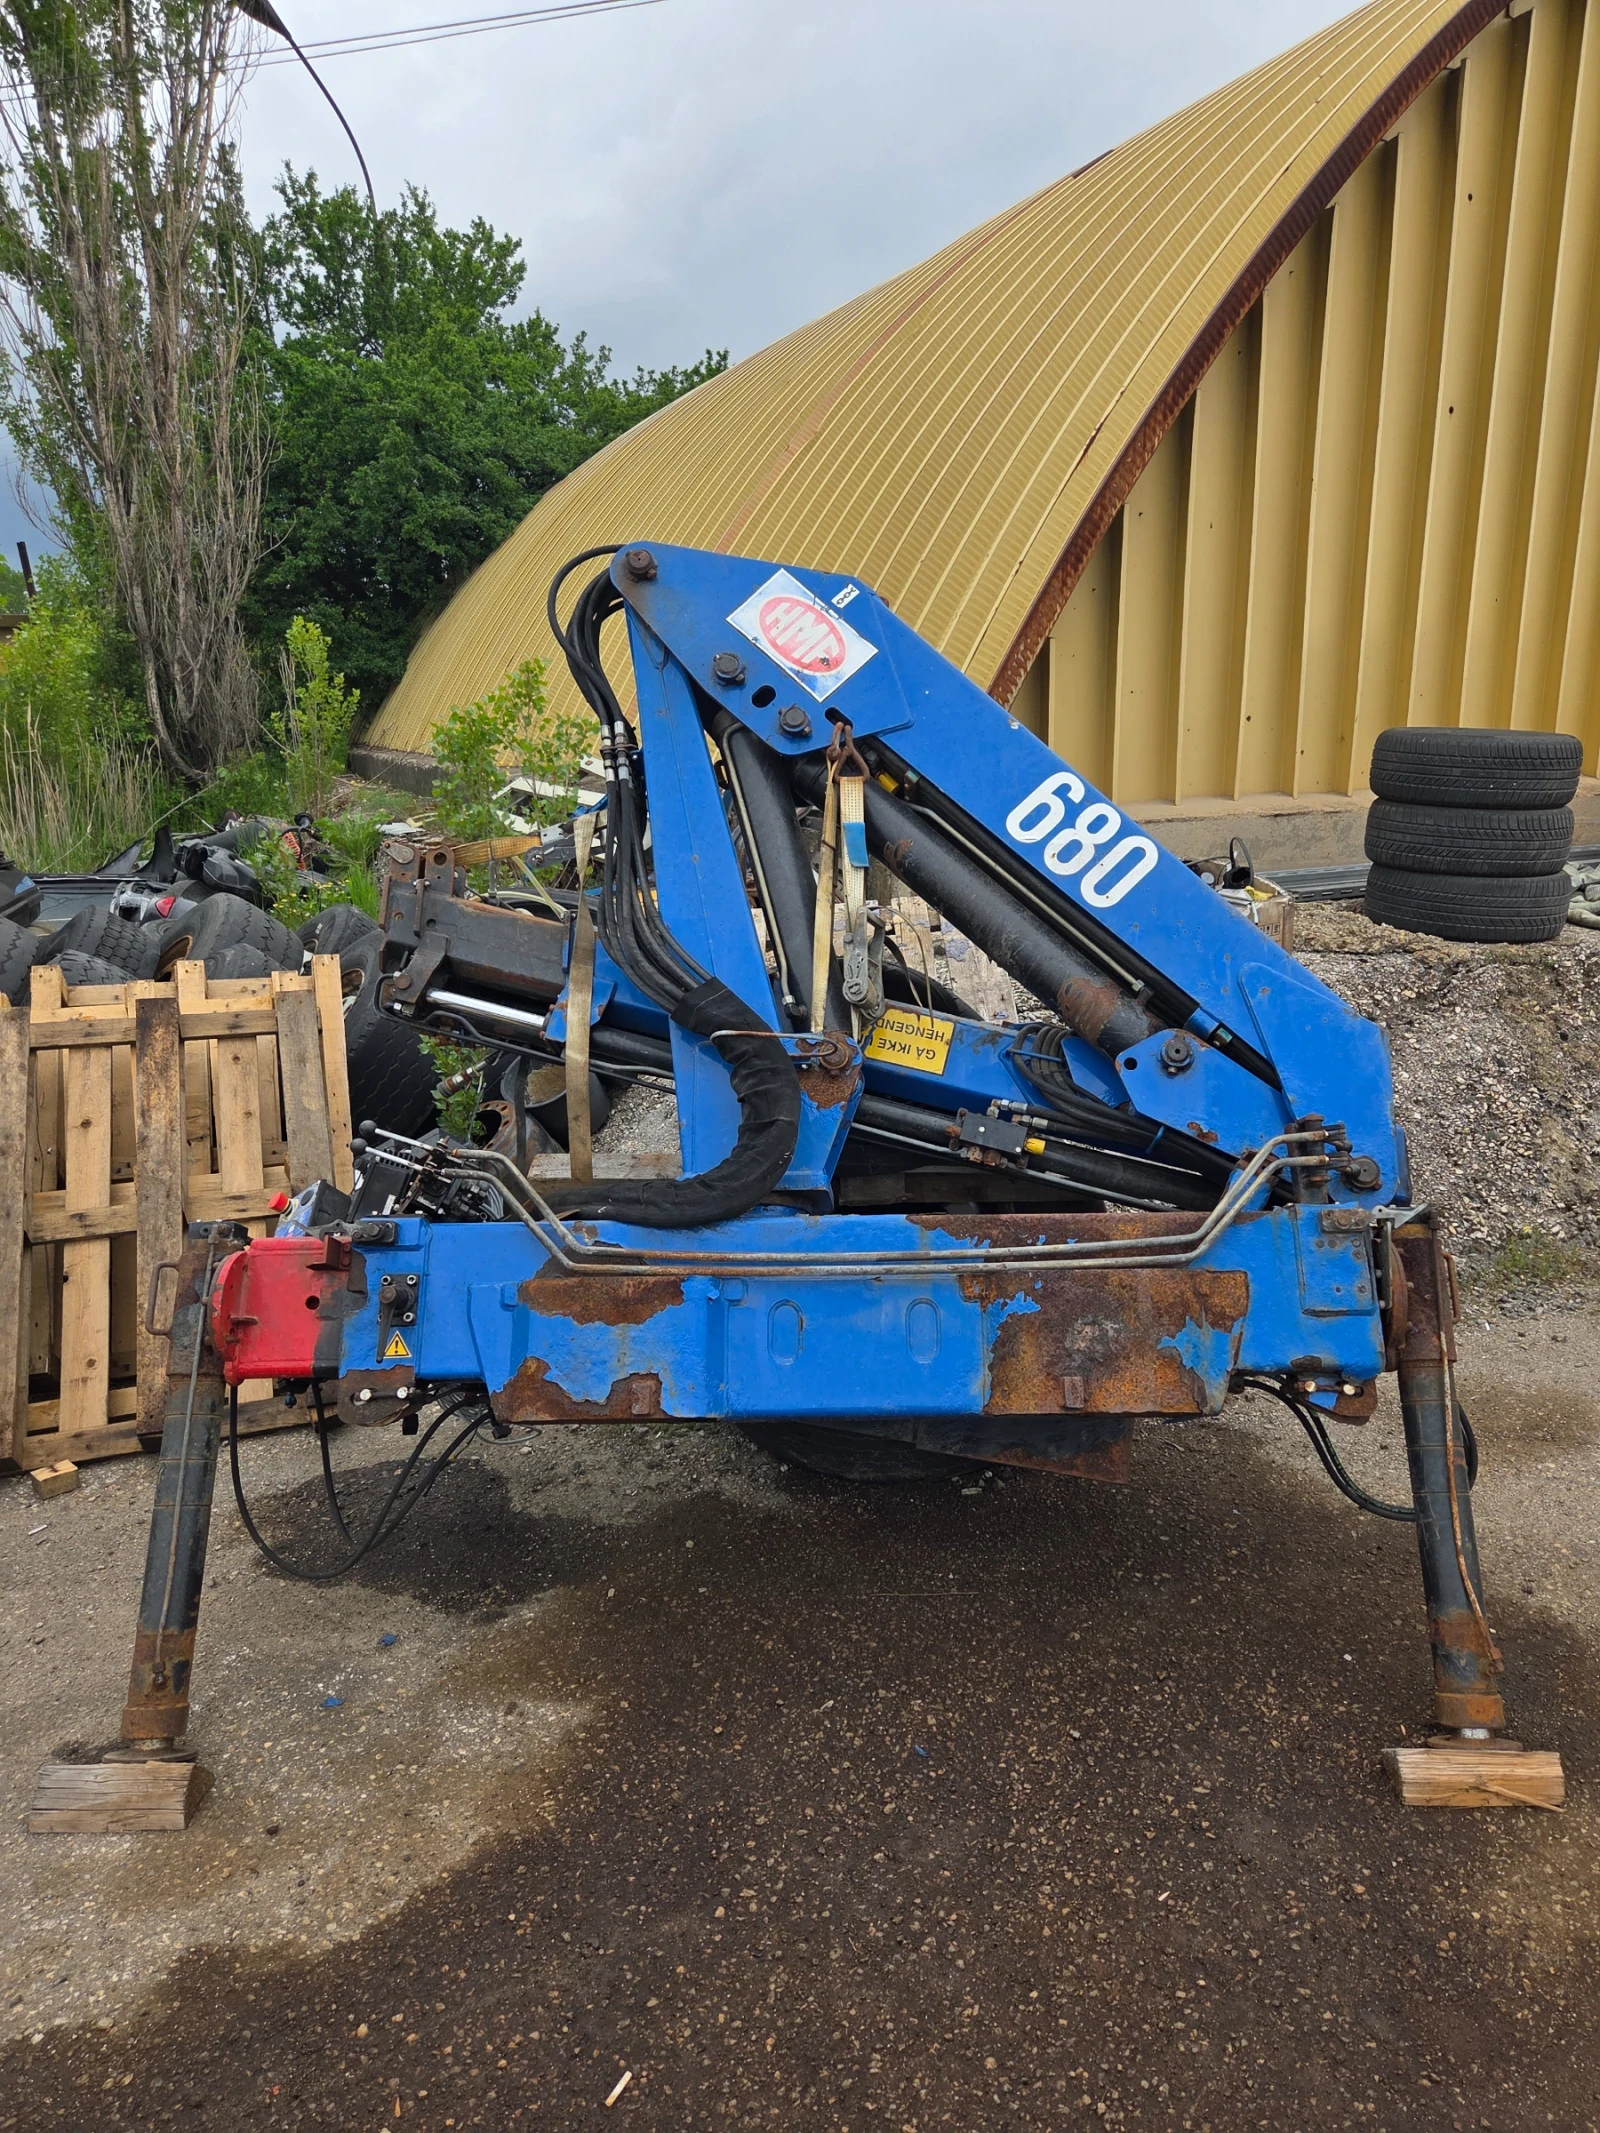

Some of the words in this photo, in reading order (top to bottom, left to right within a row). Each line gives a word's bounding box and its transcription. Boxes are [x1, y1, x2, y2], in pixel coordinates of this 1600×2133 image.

[765, 602, 840, 664] HMF
[1006, 771, 1159, 908] 680
[877, 1037, 911, 1055] IKKE
[916, 1046, 936, 1060] GÅ
